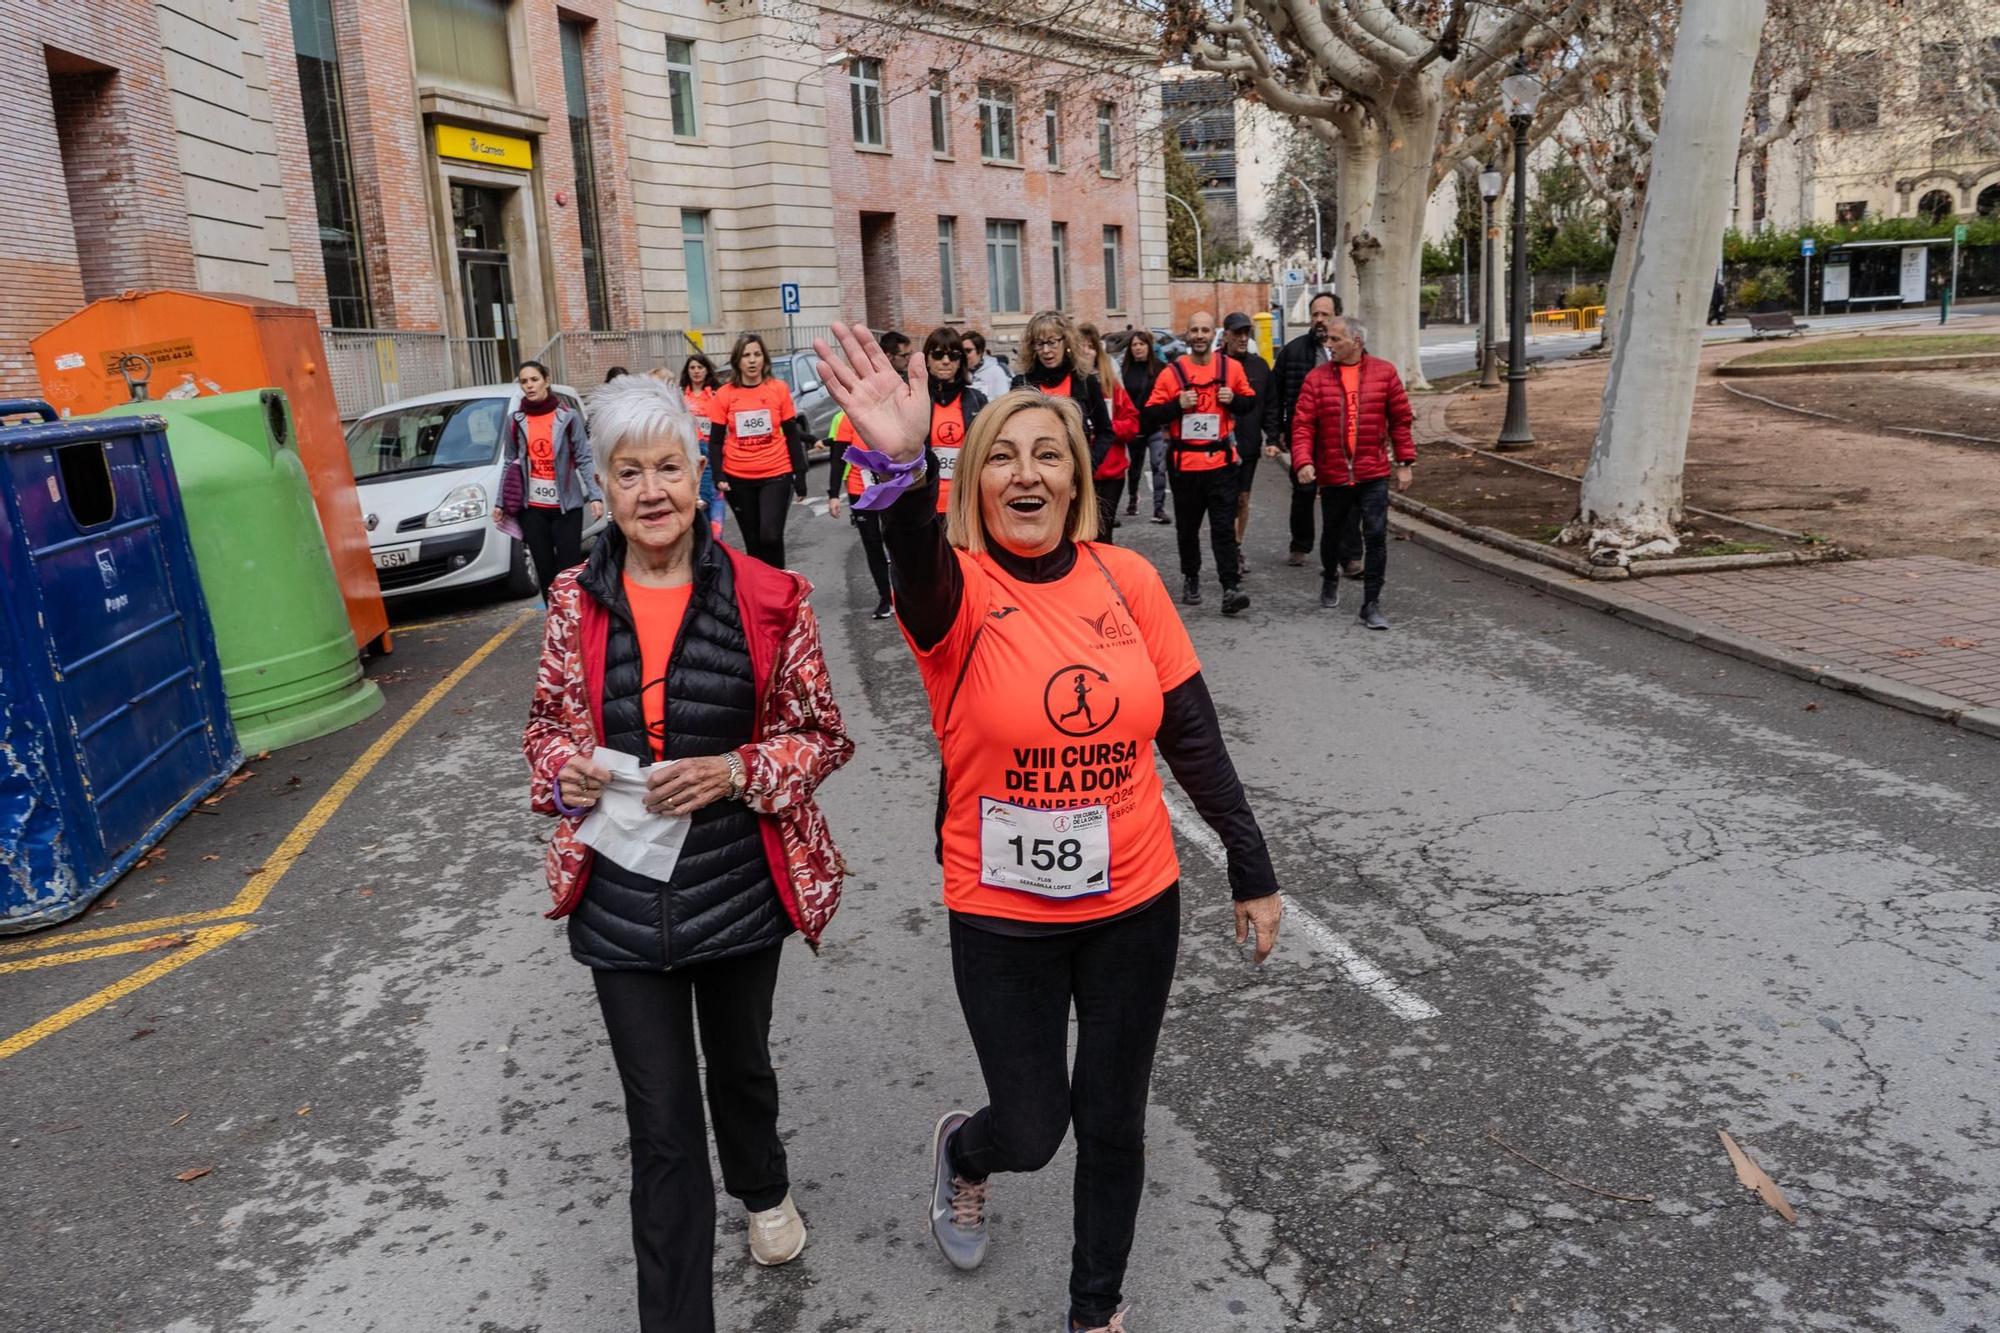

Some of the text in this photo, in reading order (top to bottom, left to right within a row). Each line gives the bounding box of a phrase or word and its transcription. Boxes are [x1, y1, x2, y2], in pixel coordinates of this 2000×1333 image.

[743, 418, 765, 429] 486
[1193, 421, 1208, 432] 24
[535, 487, 556, 498] 490
[1013, 740, 1137, 769] VIII CURSA
[1005, 769, 1039, 792] DE
[1044, 771, 1076, 793] LA
[1008, 834, 1083, 872] 158
